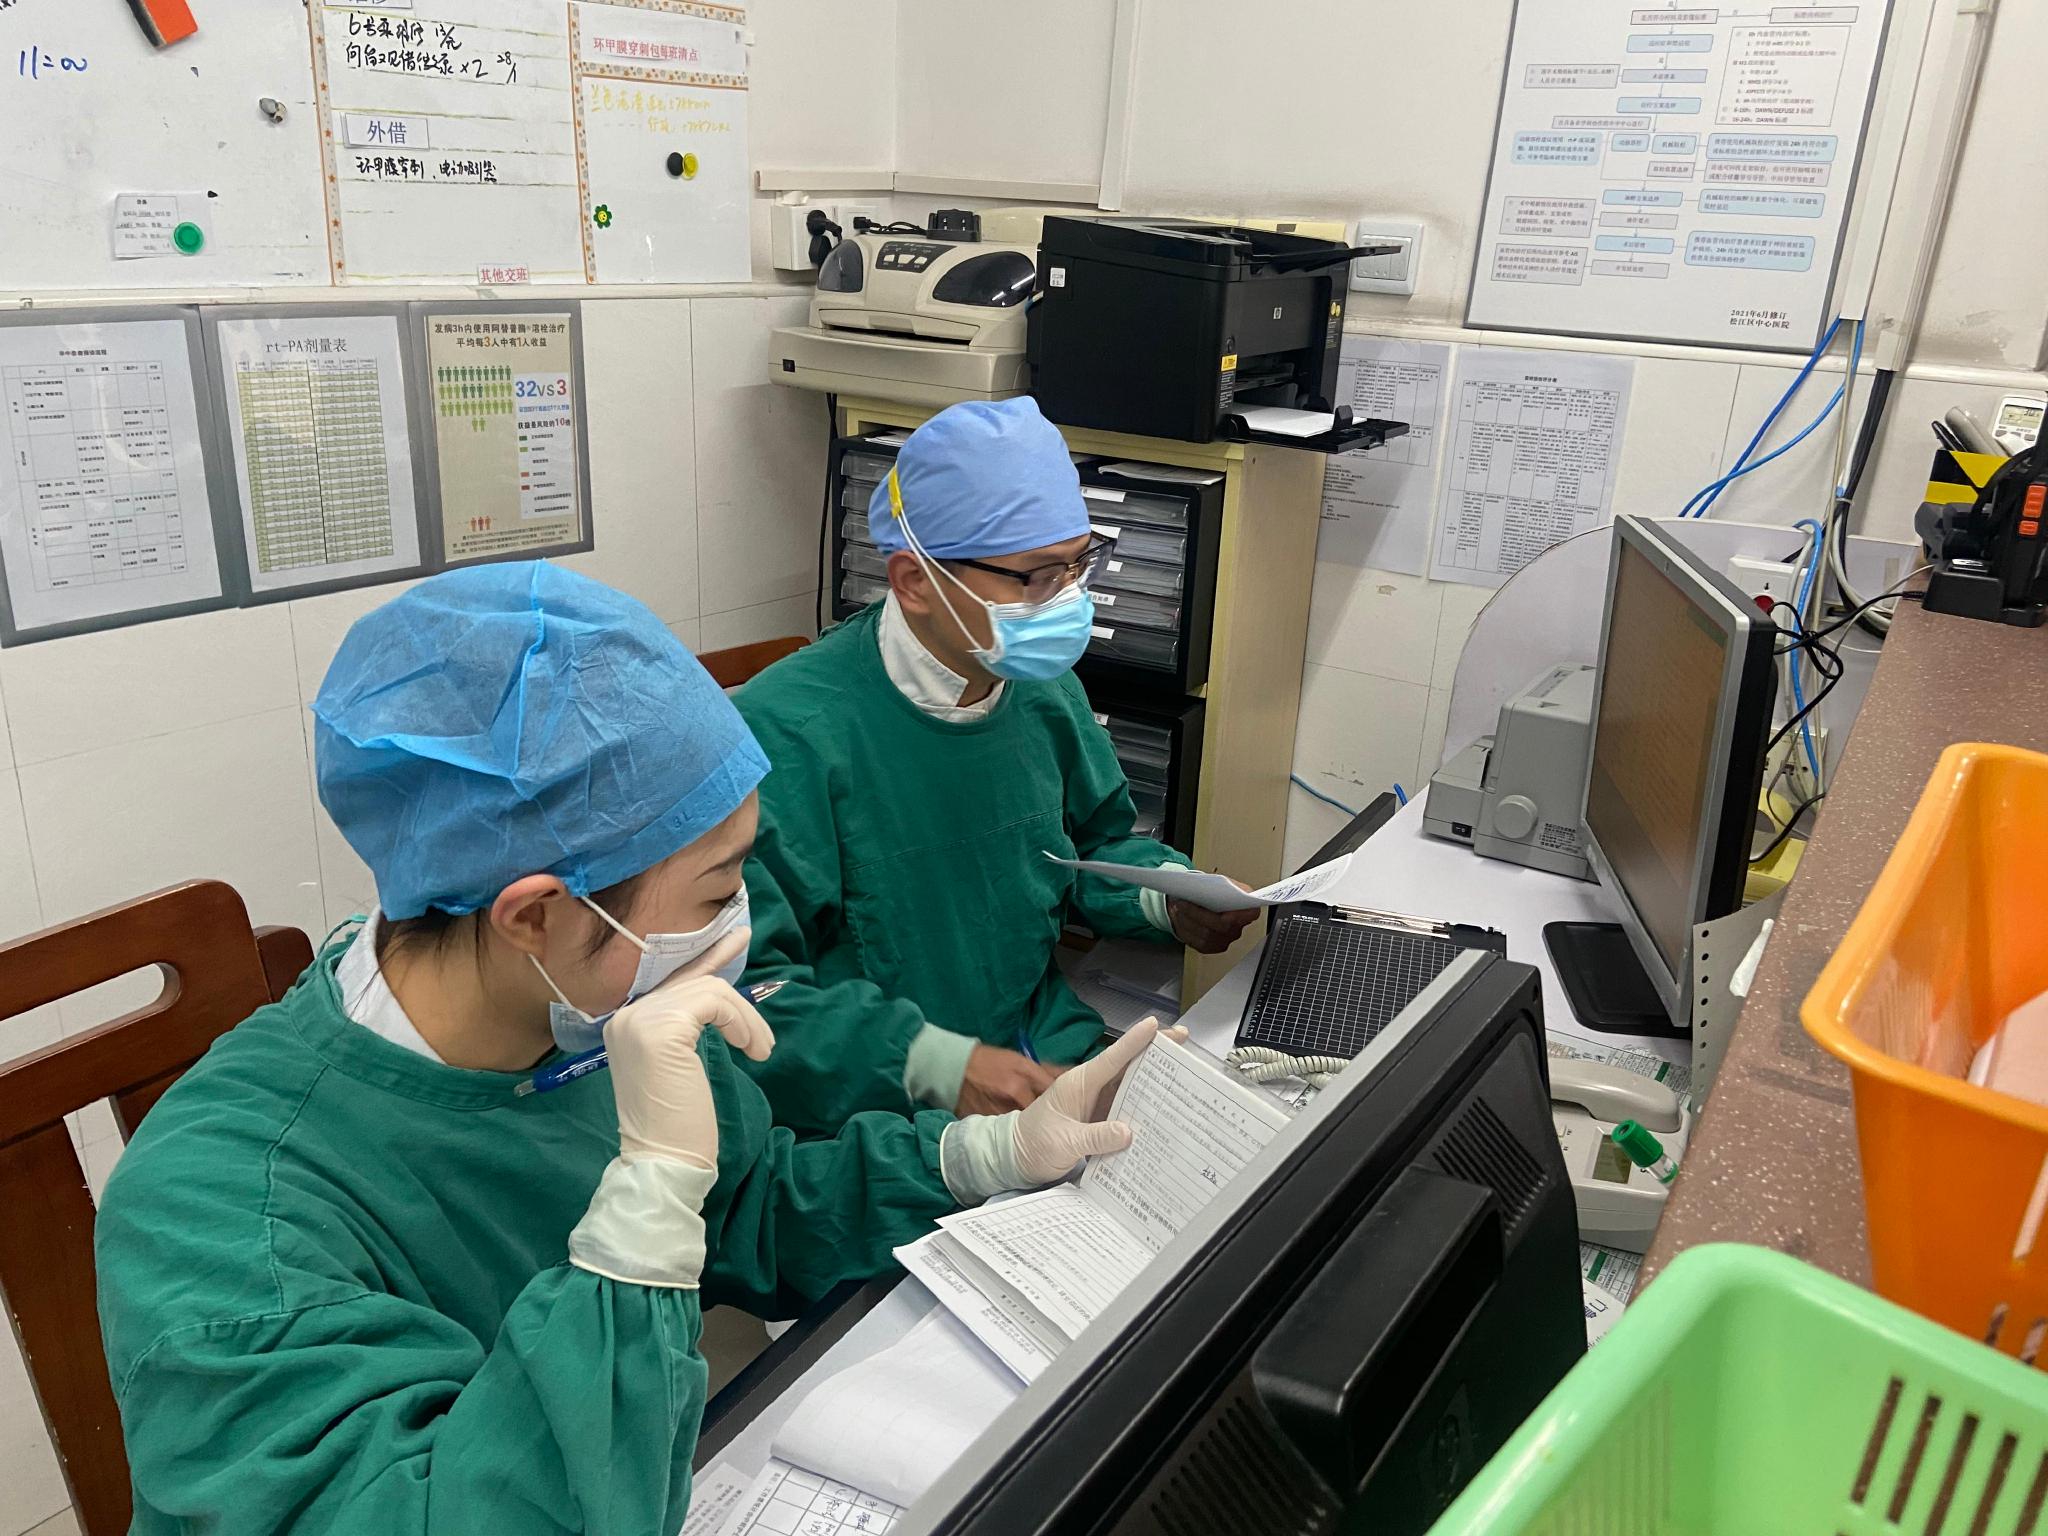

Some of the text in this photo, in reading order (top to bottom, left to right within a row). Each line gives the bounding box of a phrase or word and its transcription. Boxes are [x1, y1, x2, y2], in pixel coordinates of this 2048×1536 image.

[592, 36, 701, 62] 环甲膜穿刺包每班清点
[367, 119, 408, 145] 外借
[480, 267, 529, 284] 其他交班
[265, 338, 348, 353] rt-PA剂量表
